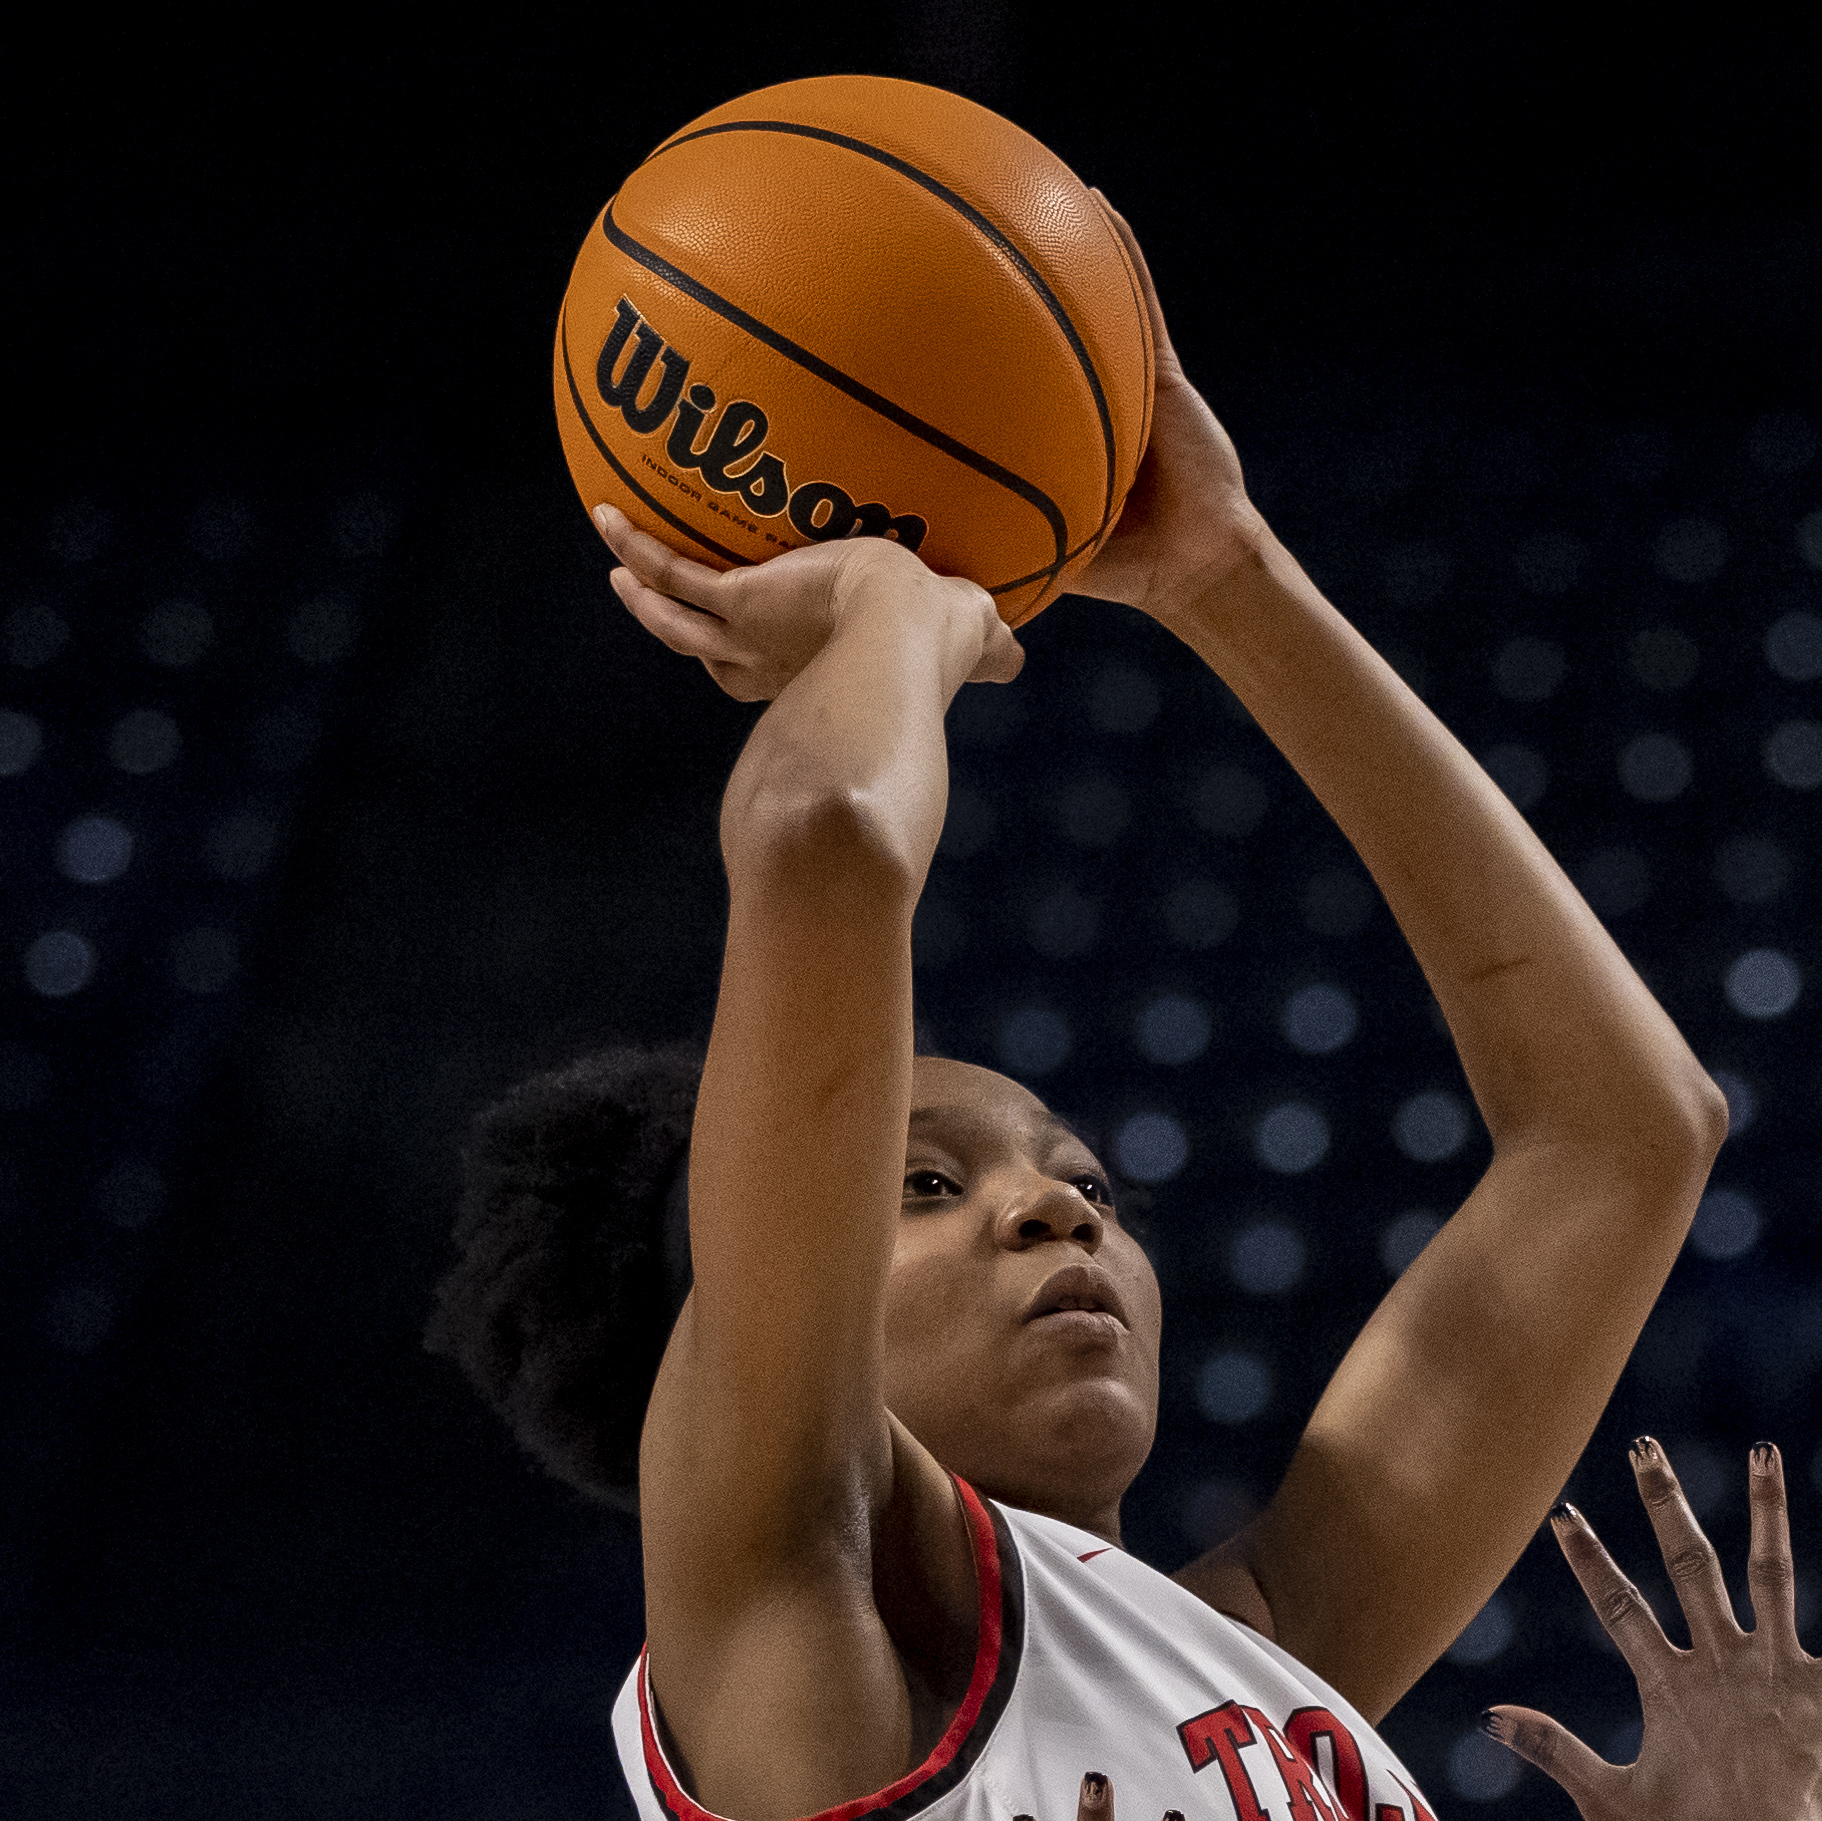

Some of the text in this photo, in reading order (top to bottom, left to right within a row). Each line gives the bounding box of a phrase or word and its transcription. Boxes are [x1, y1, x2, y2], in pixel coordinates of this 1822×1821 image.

[595, 292, 929, 552] Wilson
[640, 453, 702, 502] INDOOR
[707, 501, 759, 535] GAME
